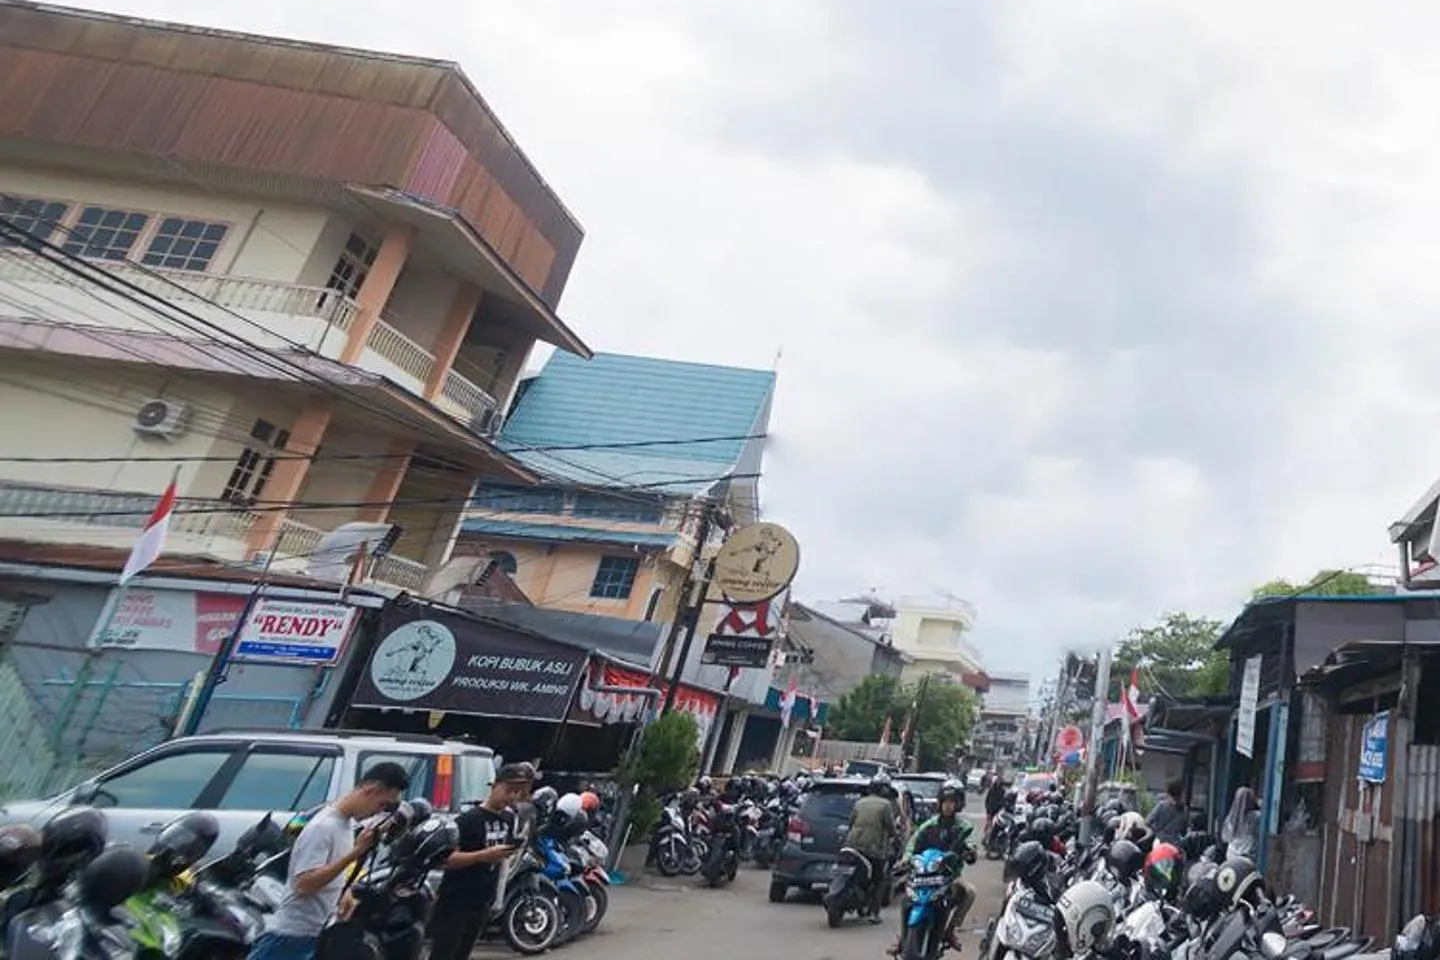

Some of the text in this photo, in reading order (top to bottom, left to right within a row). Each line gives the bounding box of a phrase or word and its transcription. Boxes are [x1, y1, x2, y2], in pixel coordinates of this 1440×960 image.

[467, 655, 574, 675] KOPI BUBUK ASLI
